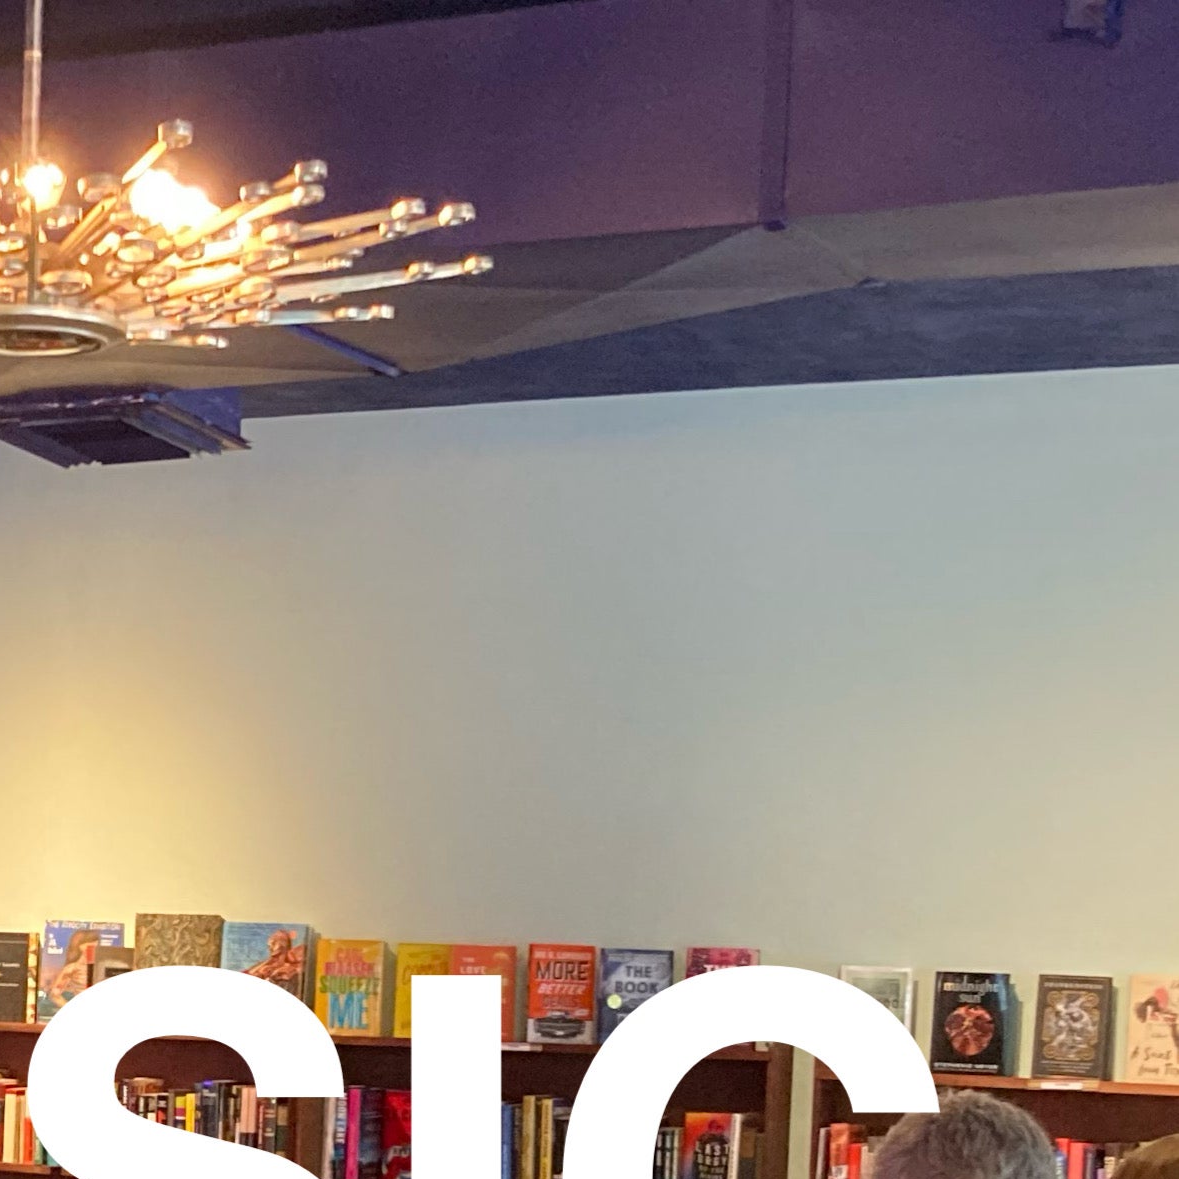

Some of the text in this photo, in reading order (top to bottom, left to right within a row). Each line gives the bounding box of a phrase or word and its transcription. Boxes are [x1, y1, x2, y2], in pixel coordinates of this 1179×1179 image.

[536, 959, 590, 981] MORE
[625, 965, 654, 979] THE
[536, 982, 589, 995] BETTER
[613, 980, 660, 994] BOOK
[942, 974, 1000, 997] midnight
[328, 990, 370, 1030] ME
[695, 1141, 730, 1156] LAST
